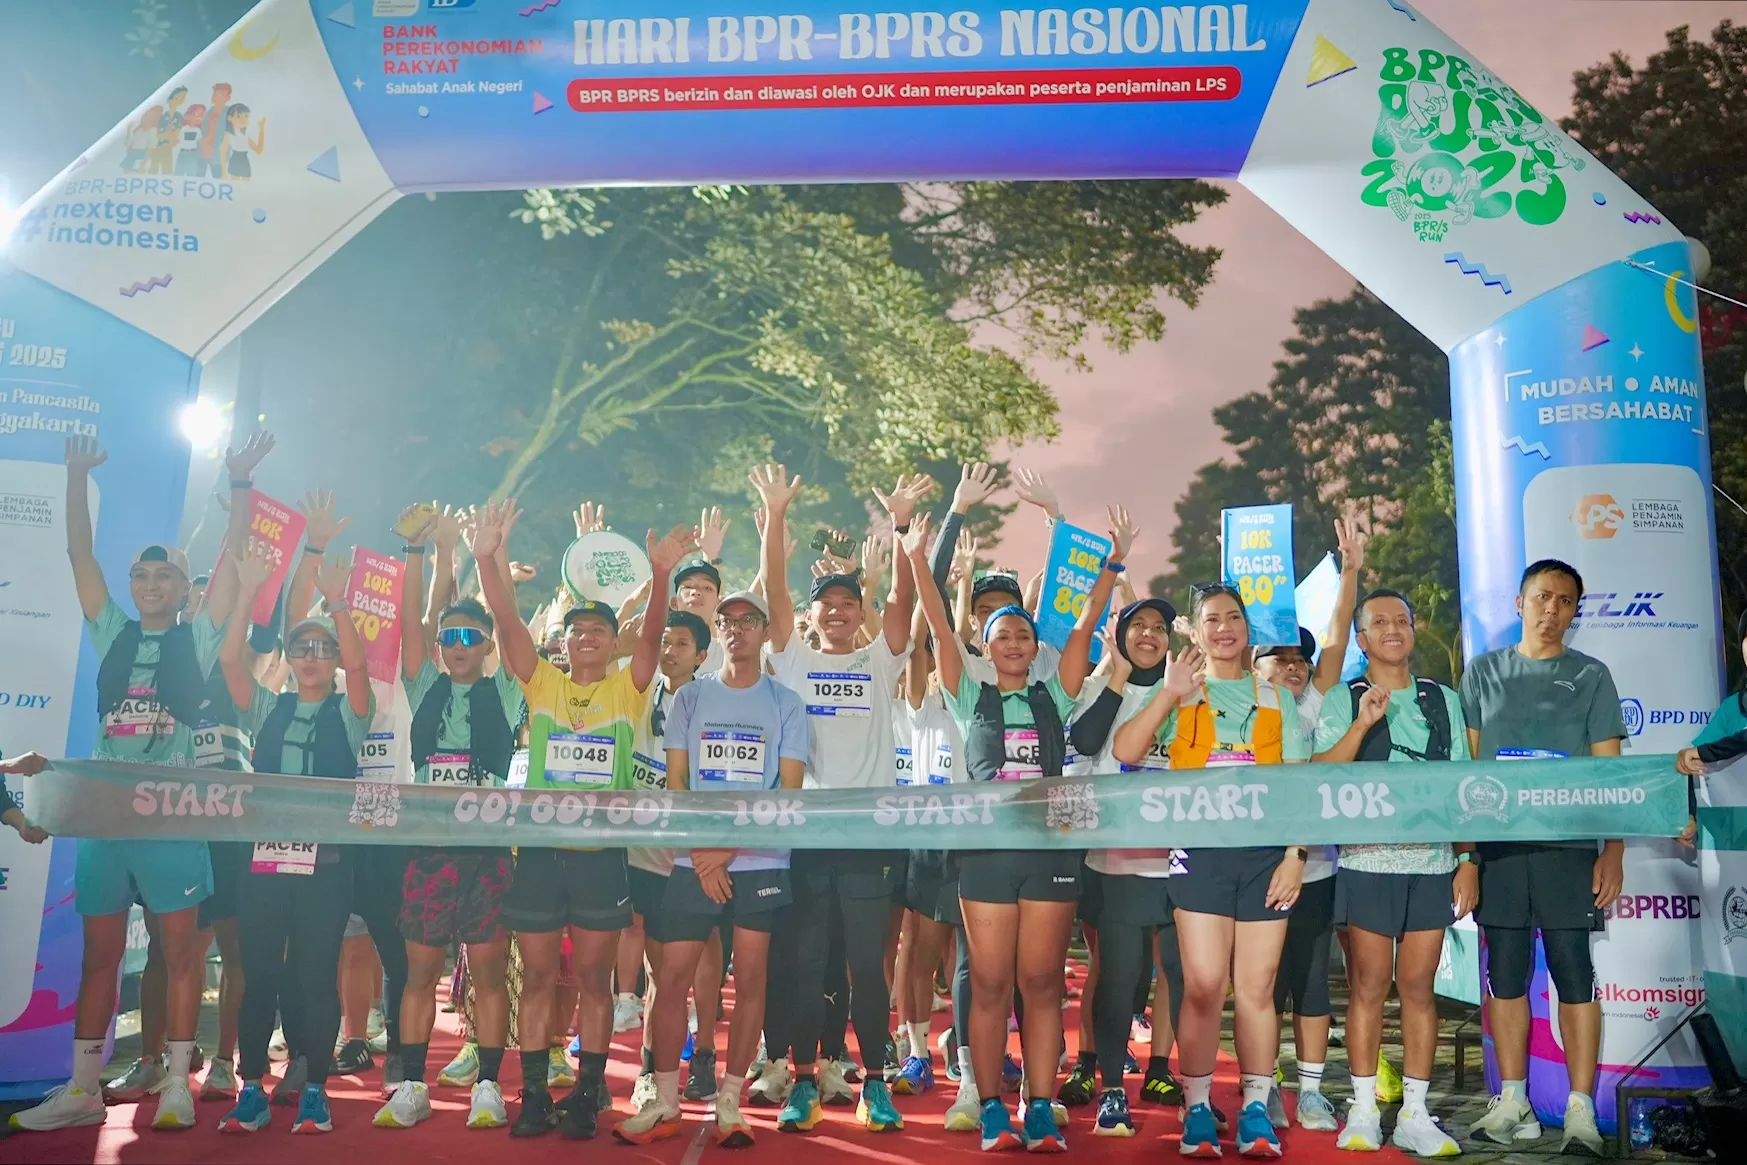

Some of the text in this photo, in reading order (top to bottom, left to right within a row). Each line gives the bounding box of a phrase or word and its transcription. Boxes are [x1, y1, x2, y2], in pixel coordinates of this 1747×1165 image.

[383, 25, 438, 39] BANK
[573, 4, 1266, 65] HARI BPR-BPRS NASIONAL
[383, 39, 543, 56] PEREKONOMIAN
[383, 59, 460, 75] RAKYAT
[386, 80, 522, 94] Sahabat Anak Negeri
[579, 77, 1227, 103] BPR BPRS berizin dan diawasi oleh OJK dan merupakan peserta penjaminan LPS
[64, 178, 233, 201] BPR-BPRS FOR
[1361, 150, 1566, 225] 2025
[1413, 219, 1448, 233] BPR/S
[48, 222, 199, 252] indonesia
[1420, 231, 1443, 243] RUN
[10, 344, 67, 369] 2025
[1521, 375, 1698, 401] MUDAH AMAN
[12, 388, 100, 413] Pancasila
[1538, 401, 1692, 425] BERSAHABAT
[1632, 503, 1679, 512] LEMBAGA
[1632, 512, 1682, 521] PENJAMIN
[0, 513, 52, 524] IMPANAN
[251, 513, 283, 541] 10K
[1633, 520, 1684, 529] SIMPANAN
[1241, 530, 1272, 549] 10K
[1068, 547, 1100, 574] 10K
[1233, 555, 1284, 575] PACER
[363, 571, 393, 596] 10K
[352, 591, 397, 619] PACER
[1586, 621, 1625, 629] Lembaga
[1667, 621, 1698, 629] Keuangan
[814, 683, 864, 697] 10253
[16, 693, 51, 709] DIY
[1650, 710, 1712, 725] BPD DIY
[553, 744, 608, 763] 10048
[706, 744, 758, 761] 10062
[132, 781, 253, 817] START
[1140, 782, 1395, 822] START 10K
[1517, 787, 1646, 806] PERBARINDO
[454, 791, 673, 829] GO! GO! GO!
[734, 793, 1000, 826] 10K START
[257, 841, 313, 853] PACER
